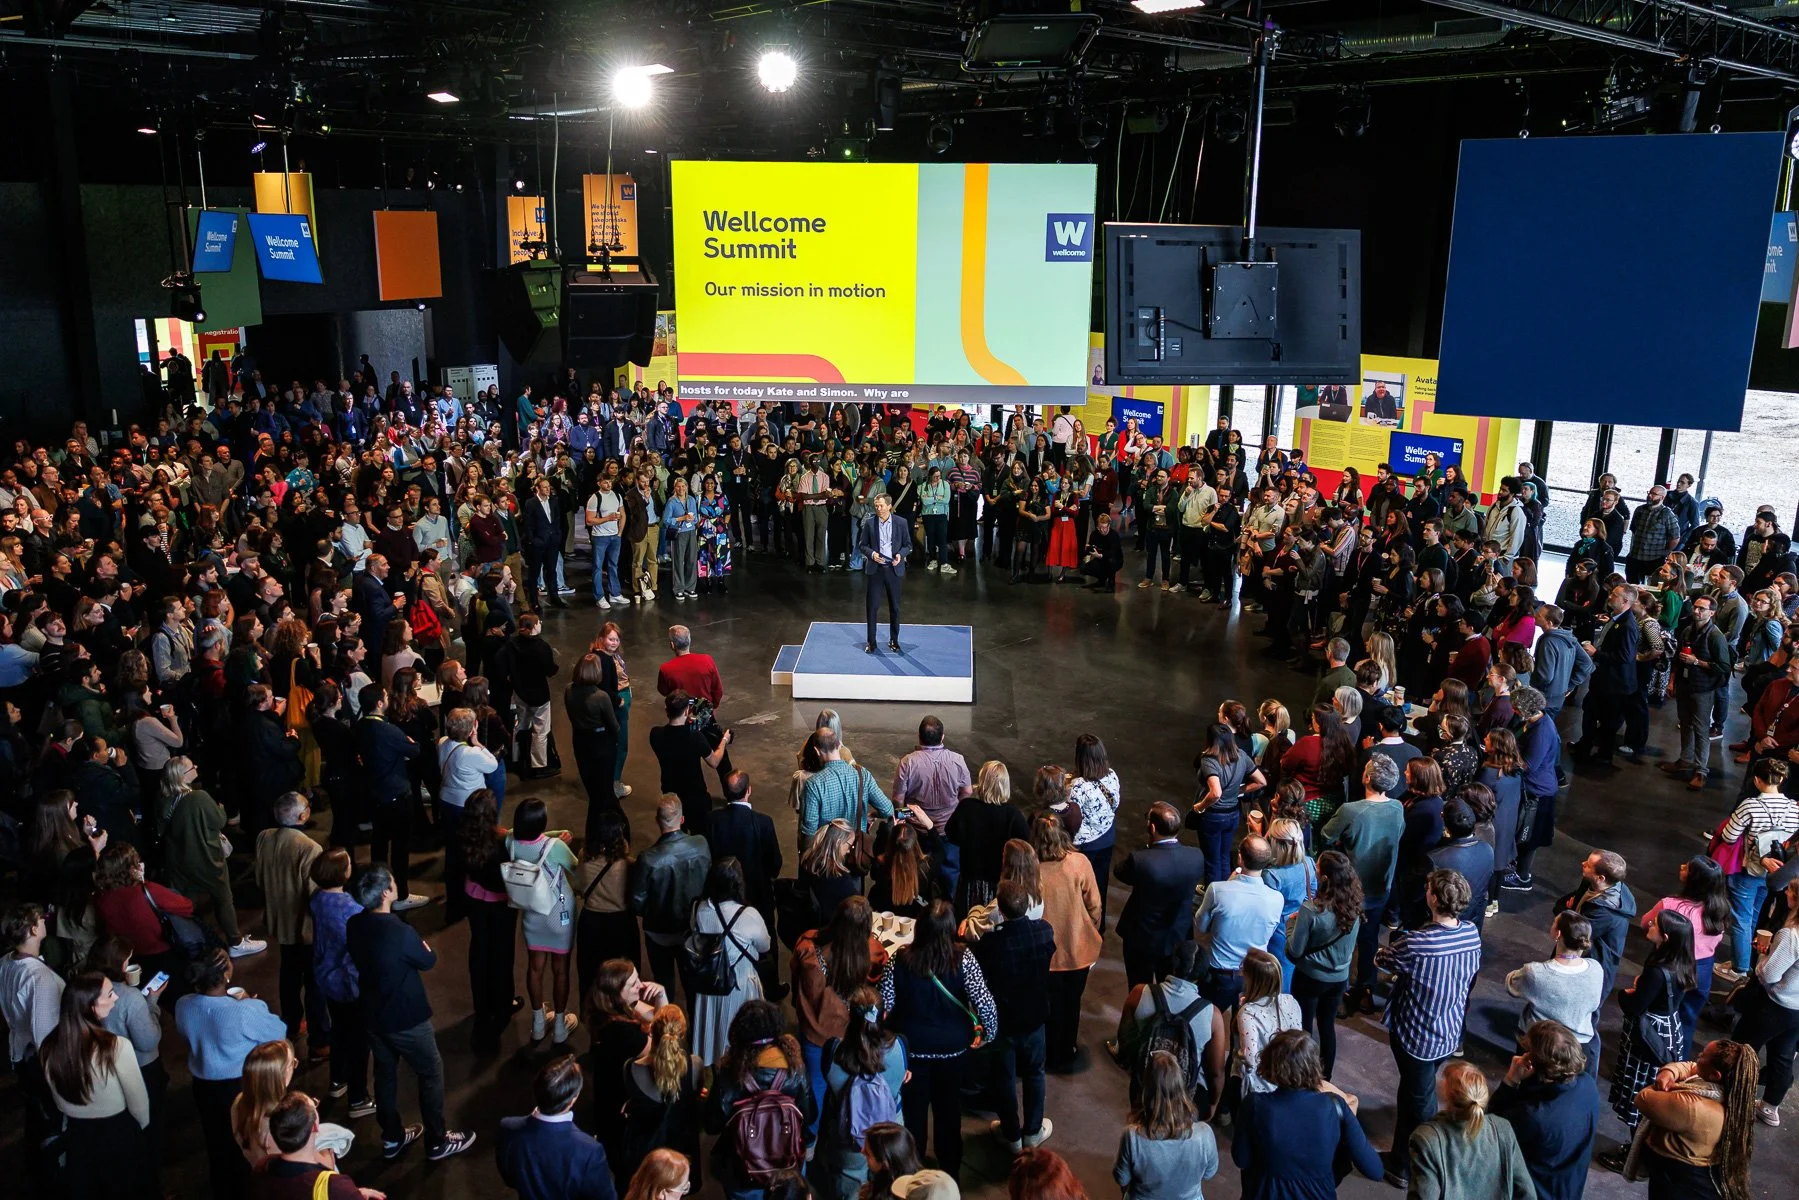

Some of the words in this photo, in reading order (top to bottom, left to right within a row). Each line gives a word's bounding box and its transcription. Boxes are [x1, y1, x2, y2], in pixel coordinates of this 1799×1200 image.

[703, 210, 827, 233] Wellcome
[206, 231, 228, 242] Wellcome
[1053, 221, 1087, 246] W
[204, 242, 222, 252] Summit
[265, 235, 299, 248] Wellcome
[704, 237, 797, 259] Summit
[269, 248, 295, 260] Summit
[704, 281, 736, 296] Our
[741, 282, 804, 297] mission
[809, 283, 824, 297] in
[828, 283, 886, 298] motion
[680, 385, 712, 395] hosts
[714, 385, 731, 395] for
[733, 386, 764, 398] today
[767, 387, 794, 396] Kate
[796, 387, 817, 397] and
[819, 387, 858, 397] Simon.
[863, 388, 888, 399] Why
[890, 390, 910, 398] are
[1123, 408, 1152, 418] Wellcome
